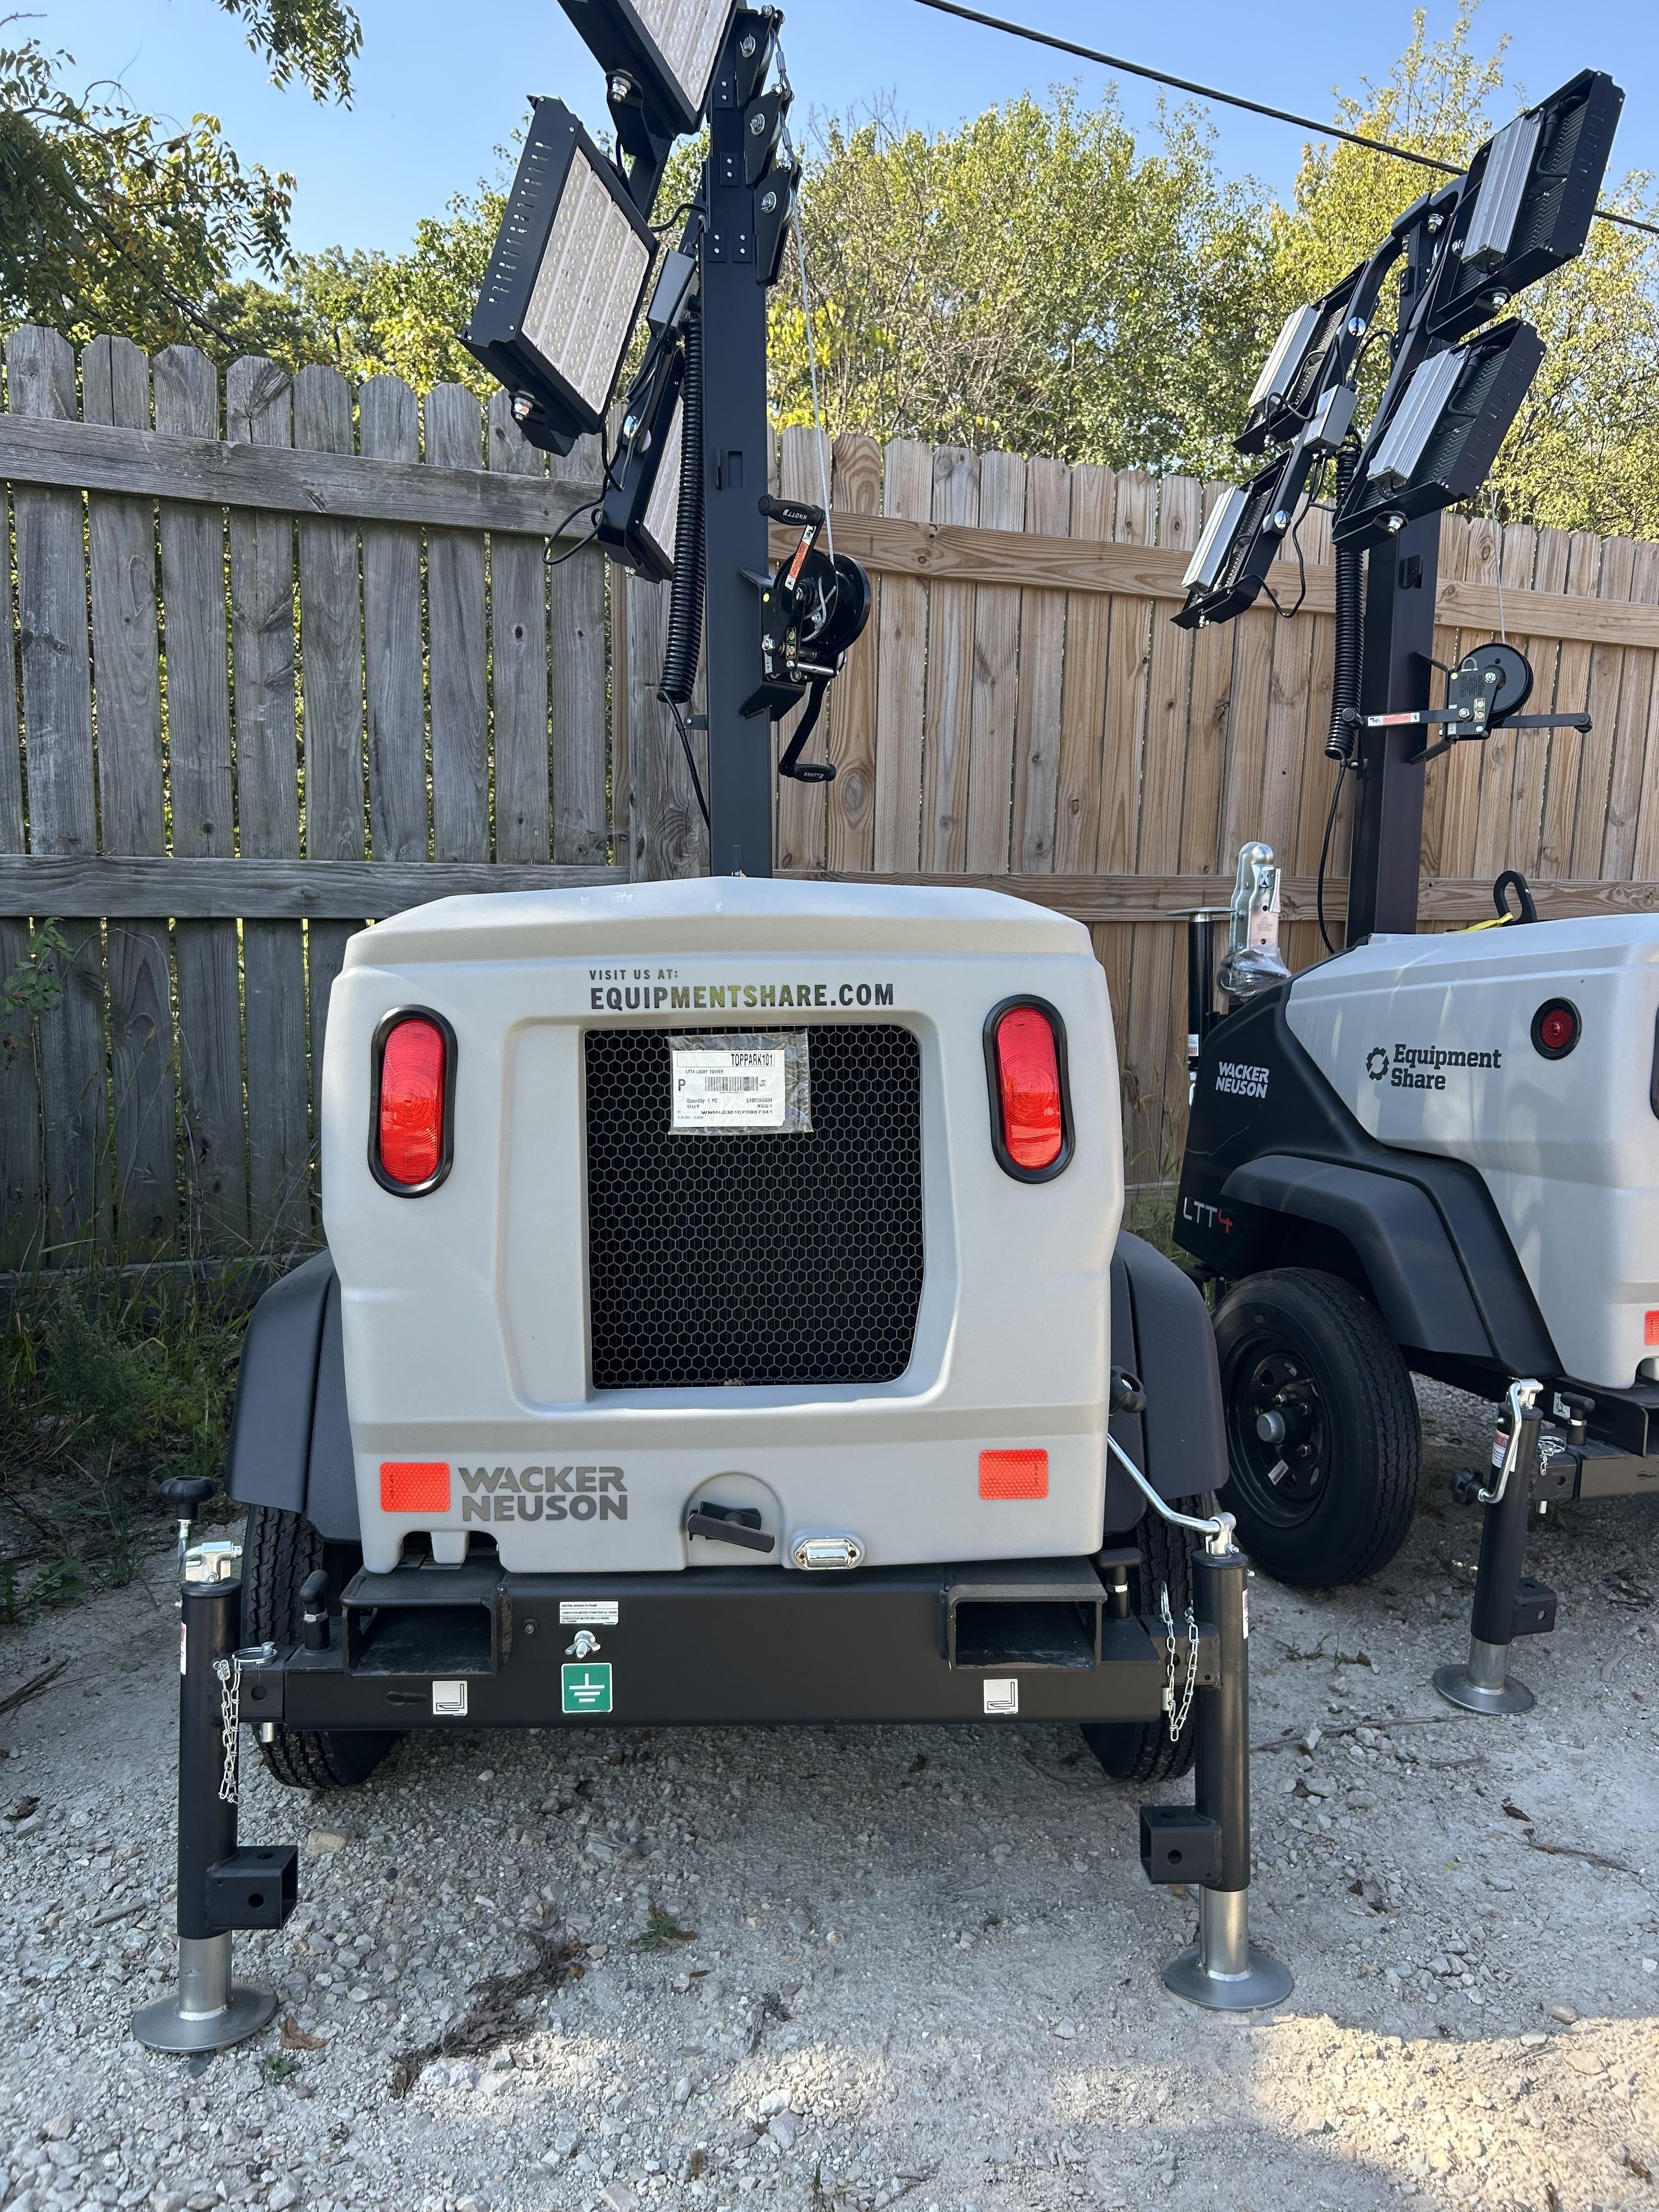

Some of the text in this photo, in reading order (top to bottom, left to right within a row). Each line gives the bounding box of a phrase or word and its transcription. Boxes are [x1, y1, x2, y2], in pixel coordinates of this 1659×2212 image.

[589, 969, 678, 980] VISIT US AT:
[591, 984, 893, 1011] EQUIPMENTSHARE.COM
[731, 1053, 772, 1066] TOPPARK101
[1393, 1043, 1502, 1070] Equipment
[1219, 1062, 1269, 1084] WACKER
[1391, 1068, 1446, 1090] Share
[678, 1079, 686, 1091] P
[1215, 1076, 1268, 1099] NEUSON
[1183, 1197, 1233, 1234] LTT4
[458, 1466, 628, 1493] WACKER
[462, 1495, 628, 1521] NEUSON
